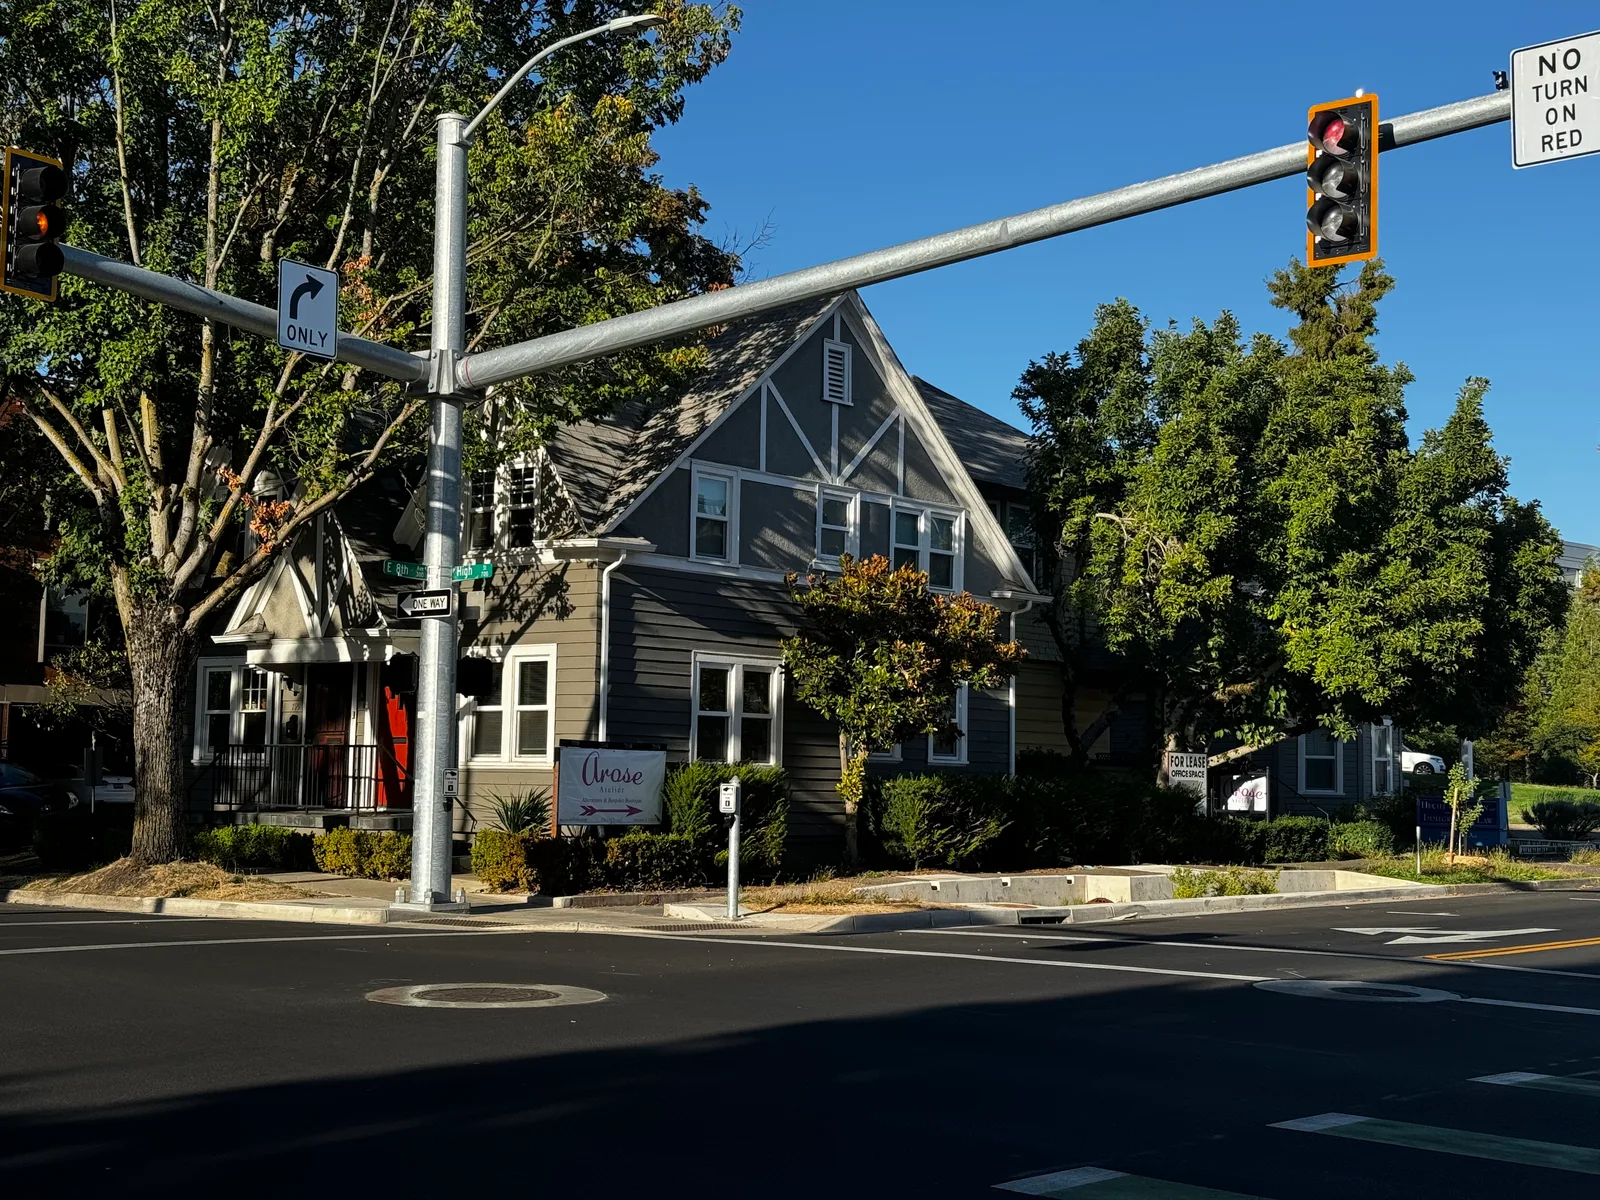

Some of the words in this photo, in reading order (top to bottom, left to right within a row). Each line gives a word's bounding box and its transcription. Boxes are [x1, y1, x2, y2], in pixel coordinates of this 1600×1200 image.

[1539, 48, 1581, 76] NO
[1532, 75, 1587, 102] TURN
[1545, 103, 1576, 125] ON
[1541, 129, 1582, 153] RED
[287, 324, 328, 348] ONLY
[386, 561, 392, 573] E
[395, 563, 409, 575] 8th
[456, 565, 473, 579] High
[412, 598, 428, 610] ONE
[429, 597, 446, 609] WAY
[582, 751, 645, 786] Arose
[1170, 755, 1184, 768] FOR
[1185, 755, 1206, 768] LEASE
[1171, 769, 1188, 778] OFFICE
[1188, 770, 1205, 779] SPACE
